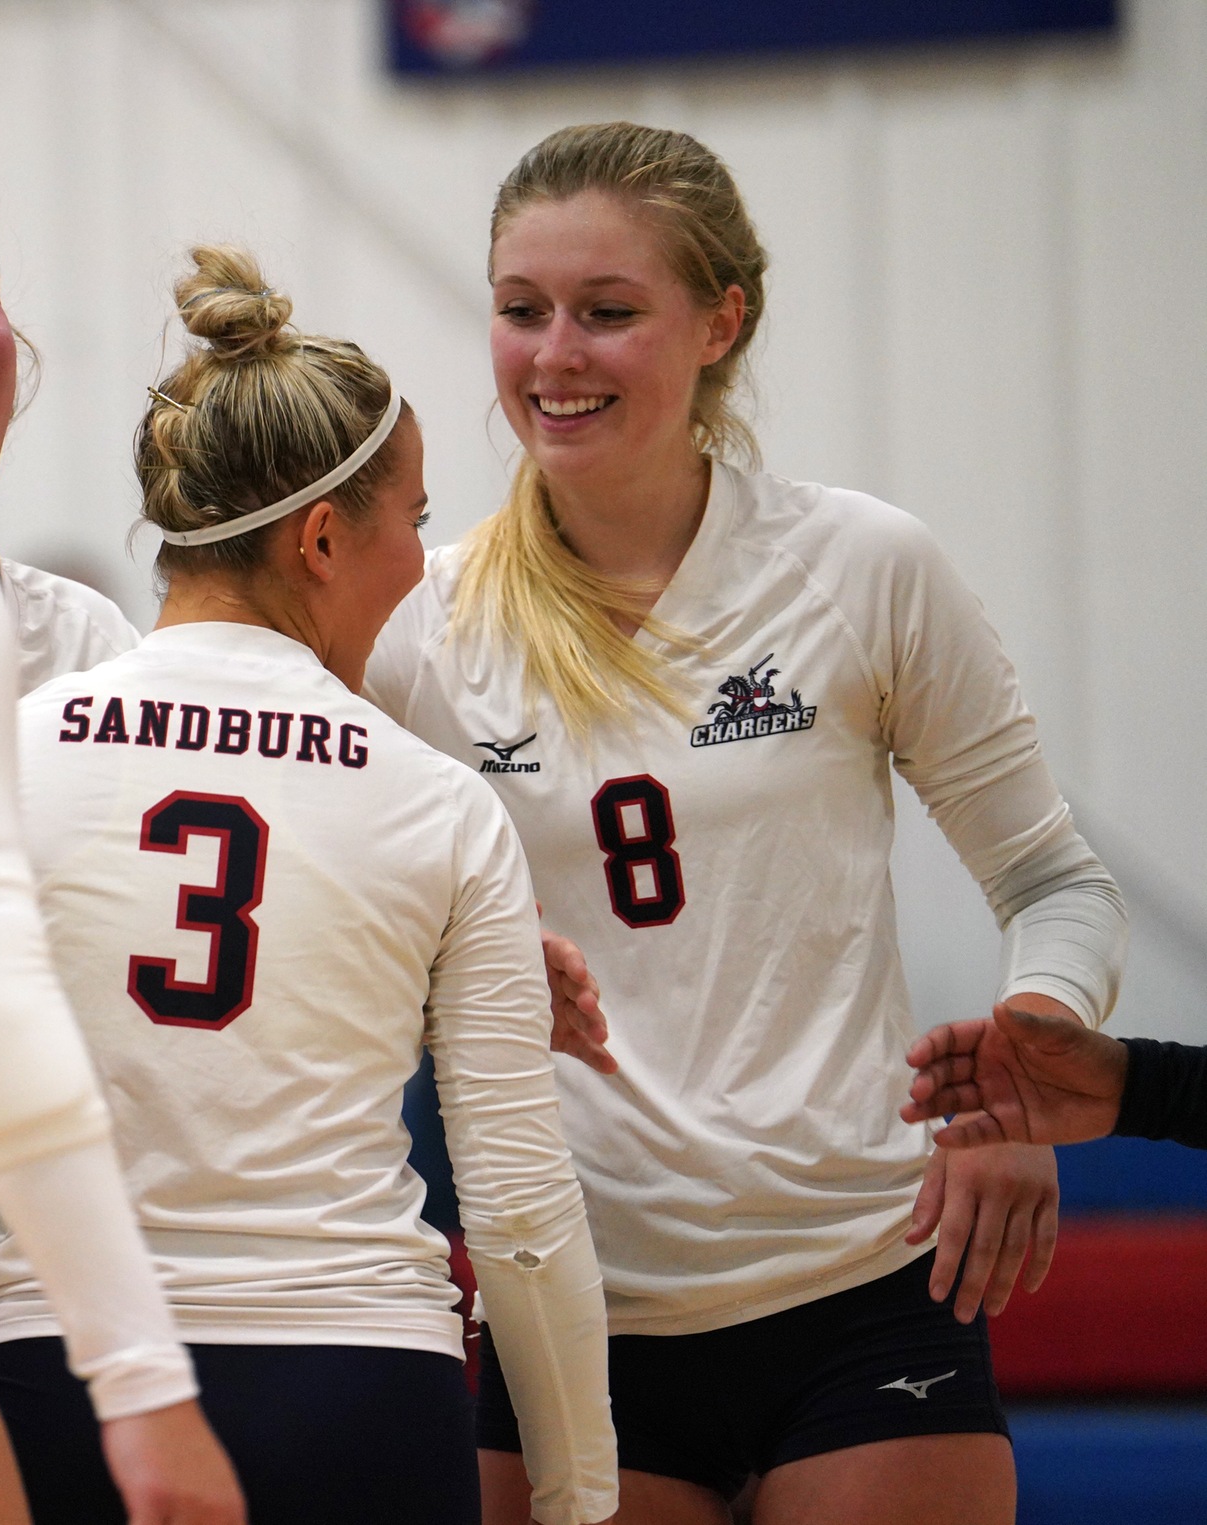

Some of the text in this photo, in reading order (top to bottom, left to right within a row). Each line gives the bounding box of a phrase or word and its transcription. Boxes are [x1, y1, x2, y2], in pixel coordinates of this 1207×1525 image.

[59, 696, 369, 769] SANDBURG
[691, 706, 817, 747] CHARGERS
[590, 773, 686, 929] 8
[127, 790, 270, 1031] 3
